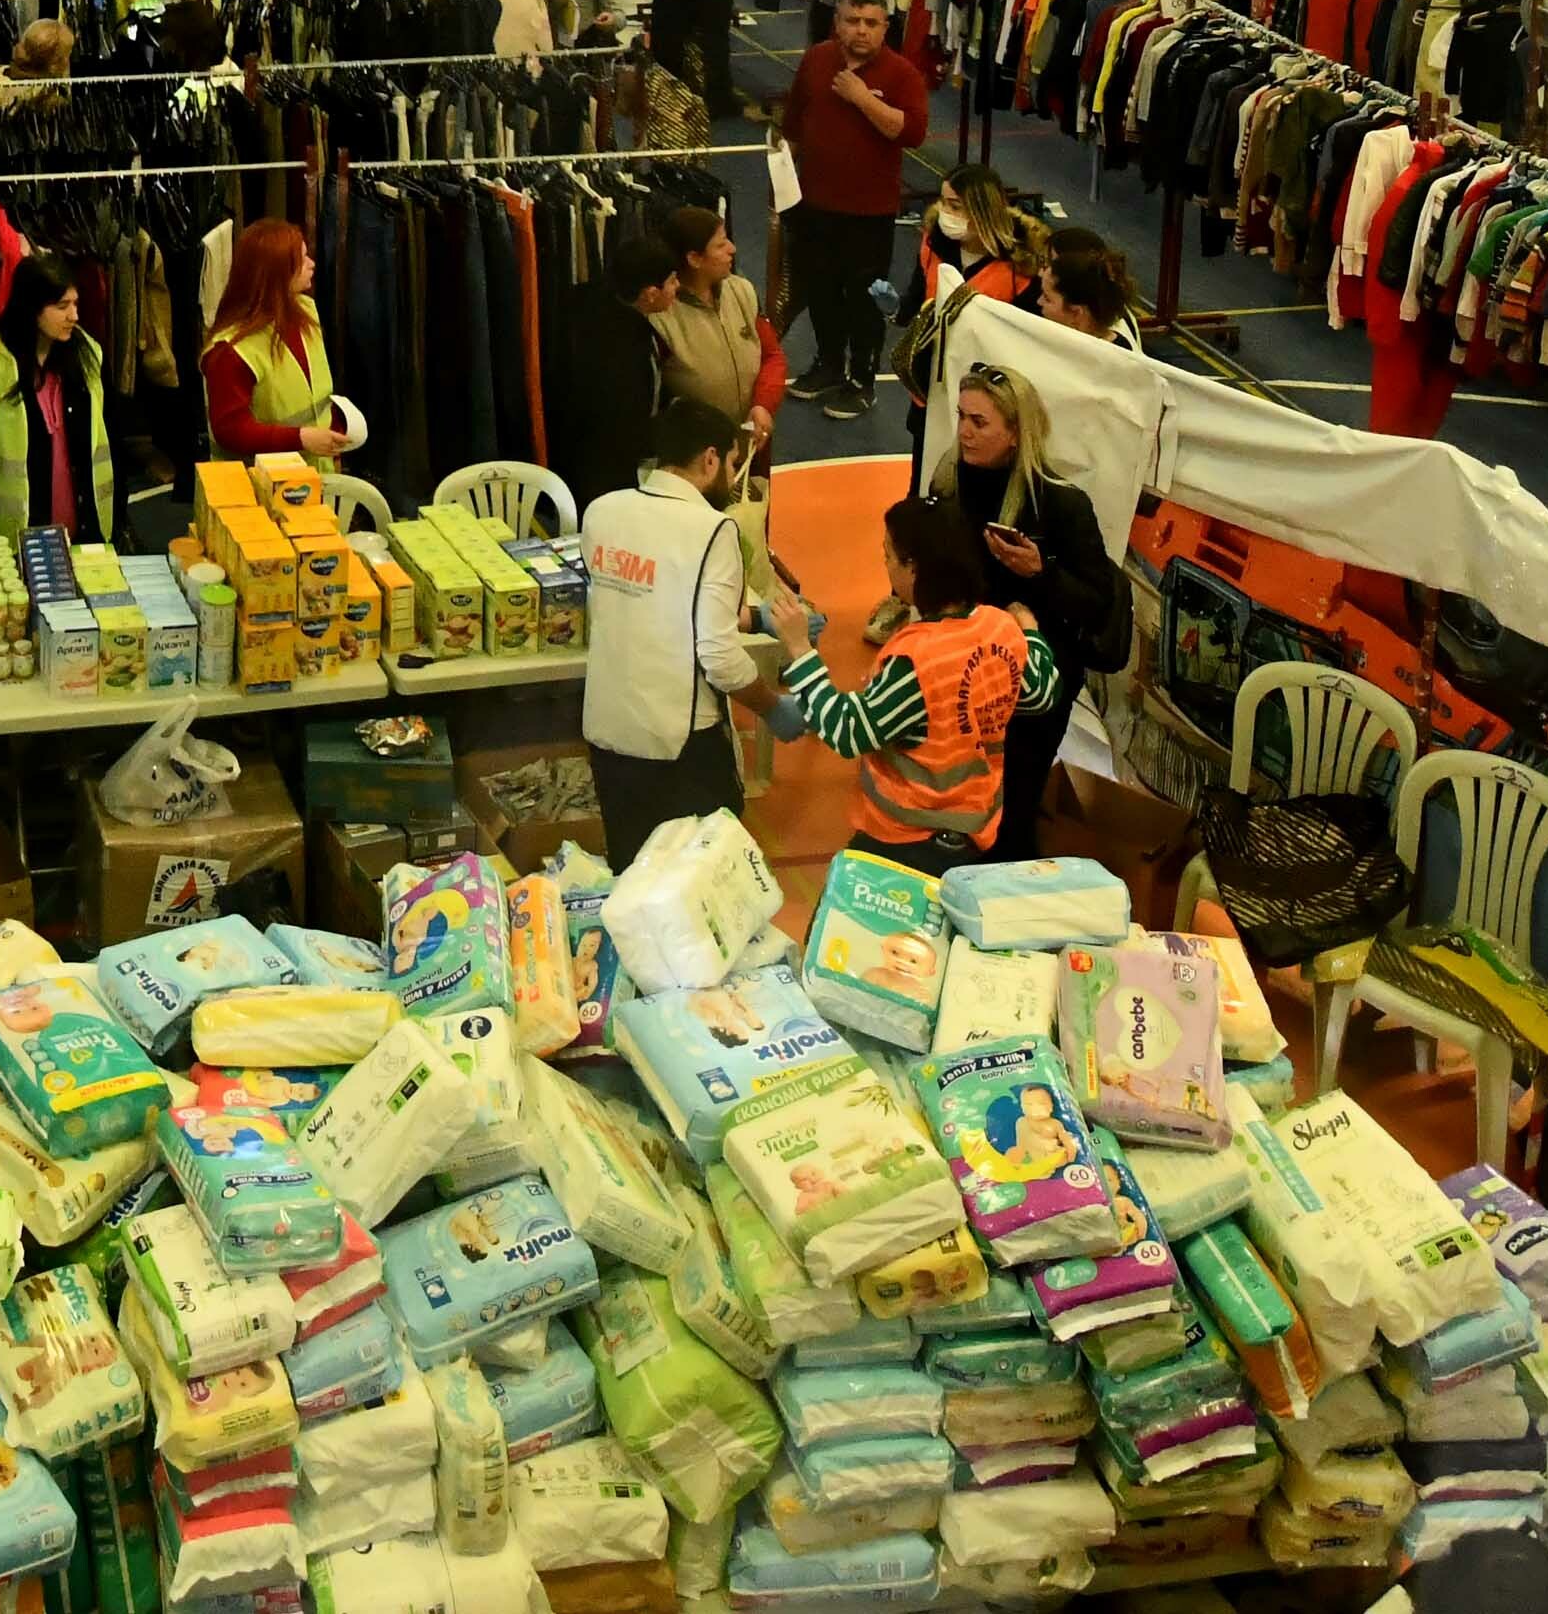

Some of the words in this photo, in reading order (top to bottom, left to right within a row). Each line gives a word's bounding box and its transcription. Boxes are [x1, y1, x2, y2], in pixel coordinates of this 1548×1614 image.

[56, 641, 95, 656] Aptamil
[153, 638, 191, 654] Aptamil
[852, 883, 915, 918] Prima
[580, 1004, 599, 1019] 60
[1131, 995, 1145, 1061] canbebe
[54, 1030, 119, 1066] Prima
[754, 1026, 839, 1063] molfix
[938, 1065, 977, 1090] Jenny
[994, 1048, 1029, 1069] Willy
[733, 1079, 809, 1126] EKONOMİK
[810, 1063, 856, 1096] PAKET
[305, 1105, 335, 1145] Sleepy
[1290, 1110, 1352, 1153] Sleepy
[1069, 1167, 1089, 1183] 60
[502, 1225, 573, 1263] molfix
[1139, 1244, 1161, 1260] 60
